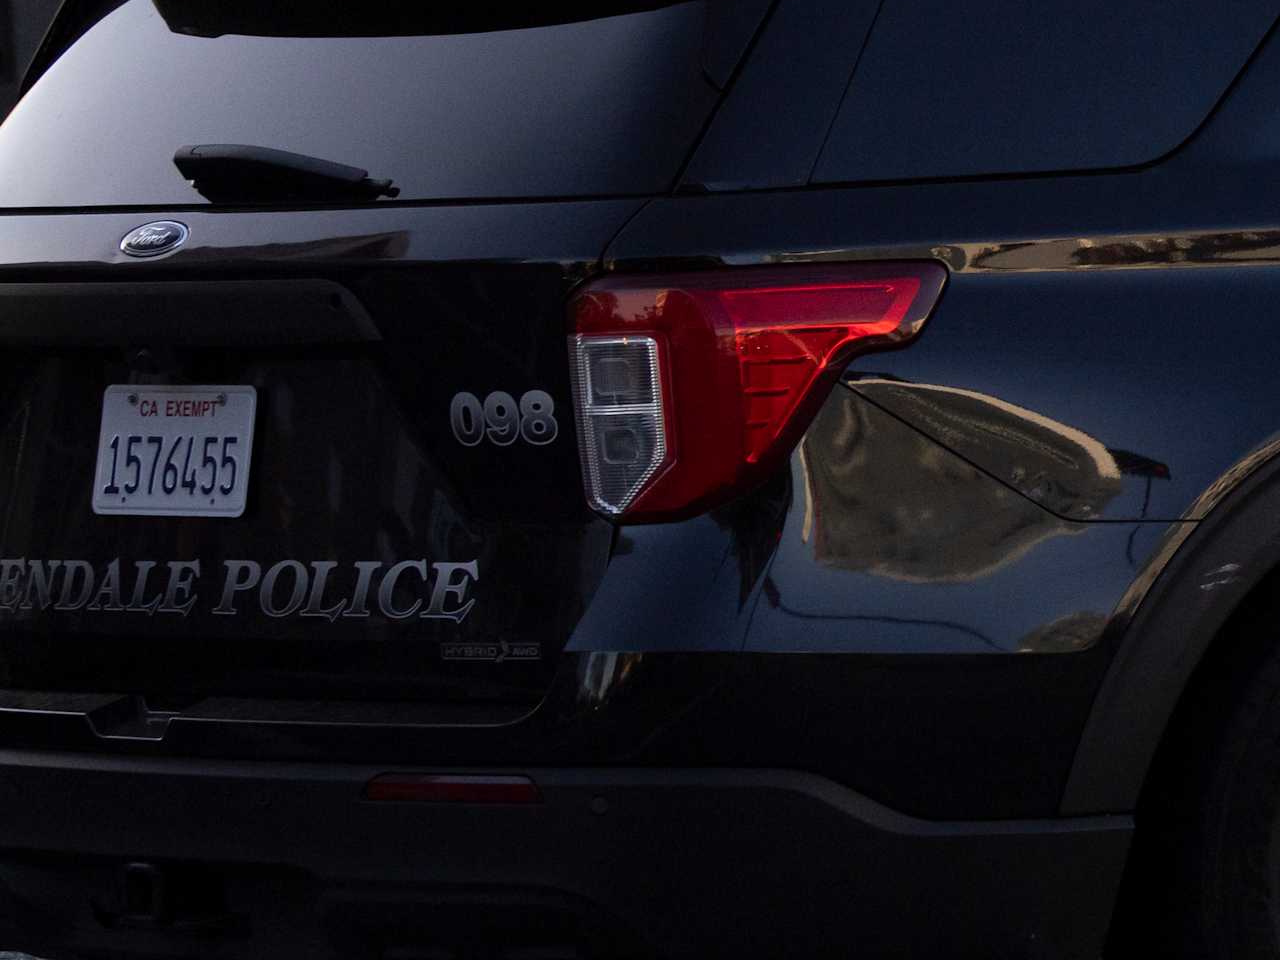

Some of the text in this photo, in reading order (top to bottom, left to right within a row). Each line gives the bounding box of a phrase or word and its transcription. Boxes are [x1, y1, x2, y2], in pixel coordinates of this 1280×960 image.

[139, 400, 219, 418] CA EXEMPT
[449, 389, 559, 447] 098
[103, 435, 238, 496] 1576455
[212, 557, 480, 624] POLICE
[444, 646, 498, 657] HYBRID
